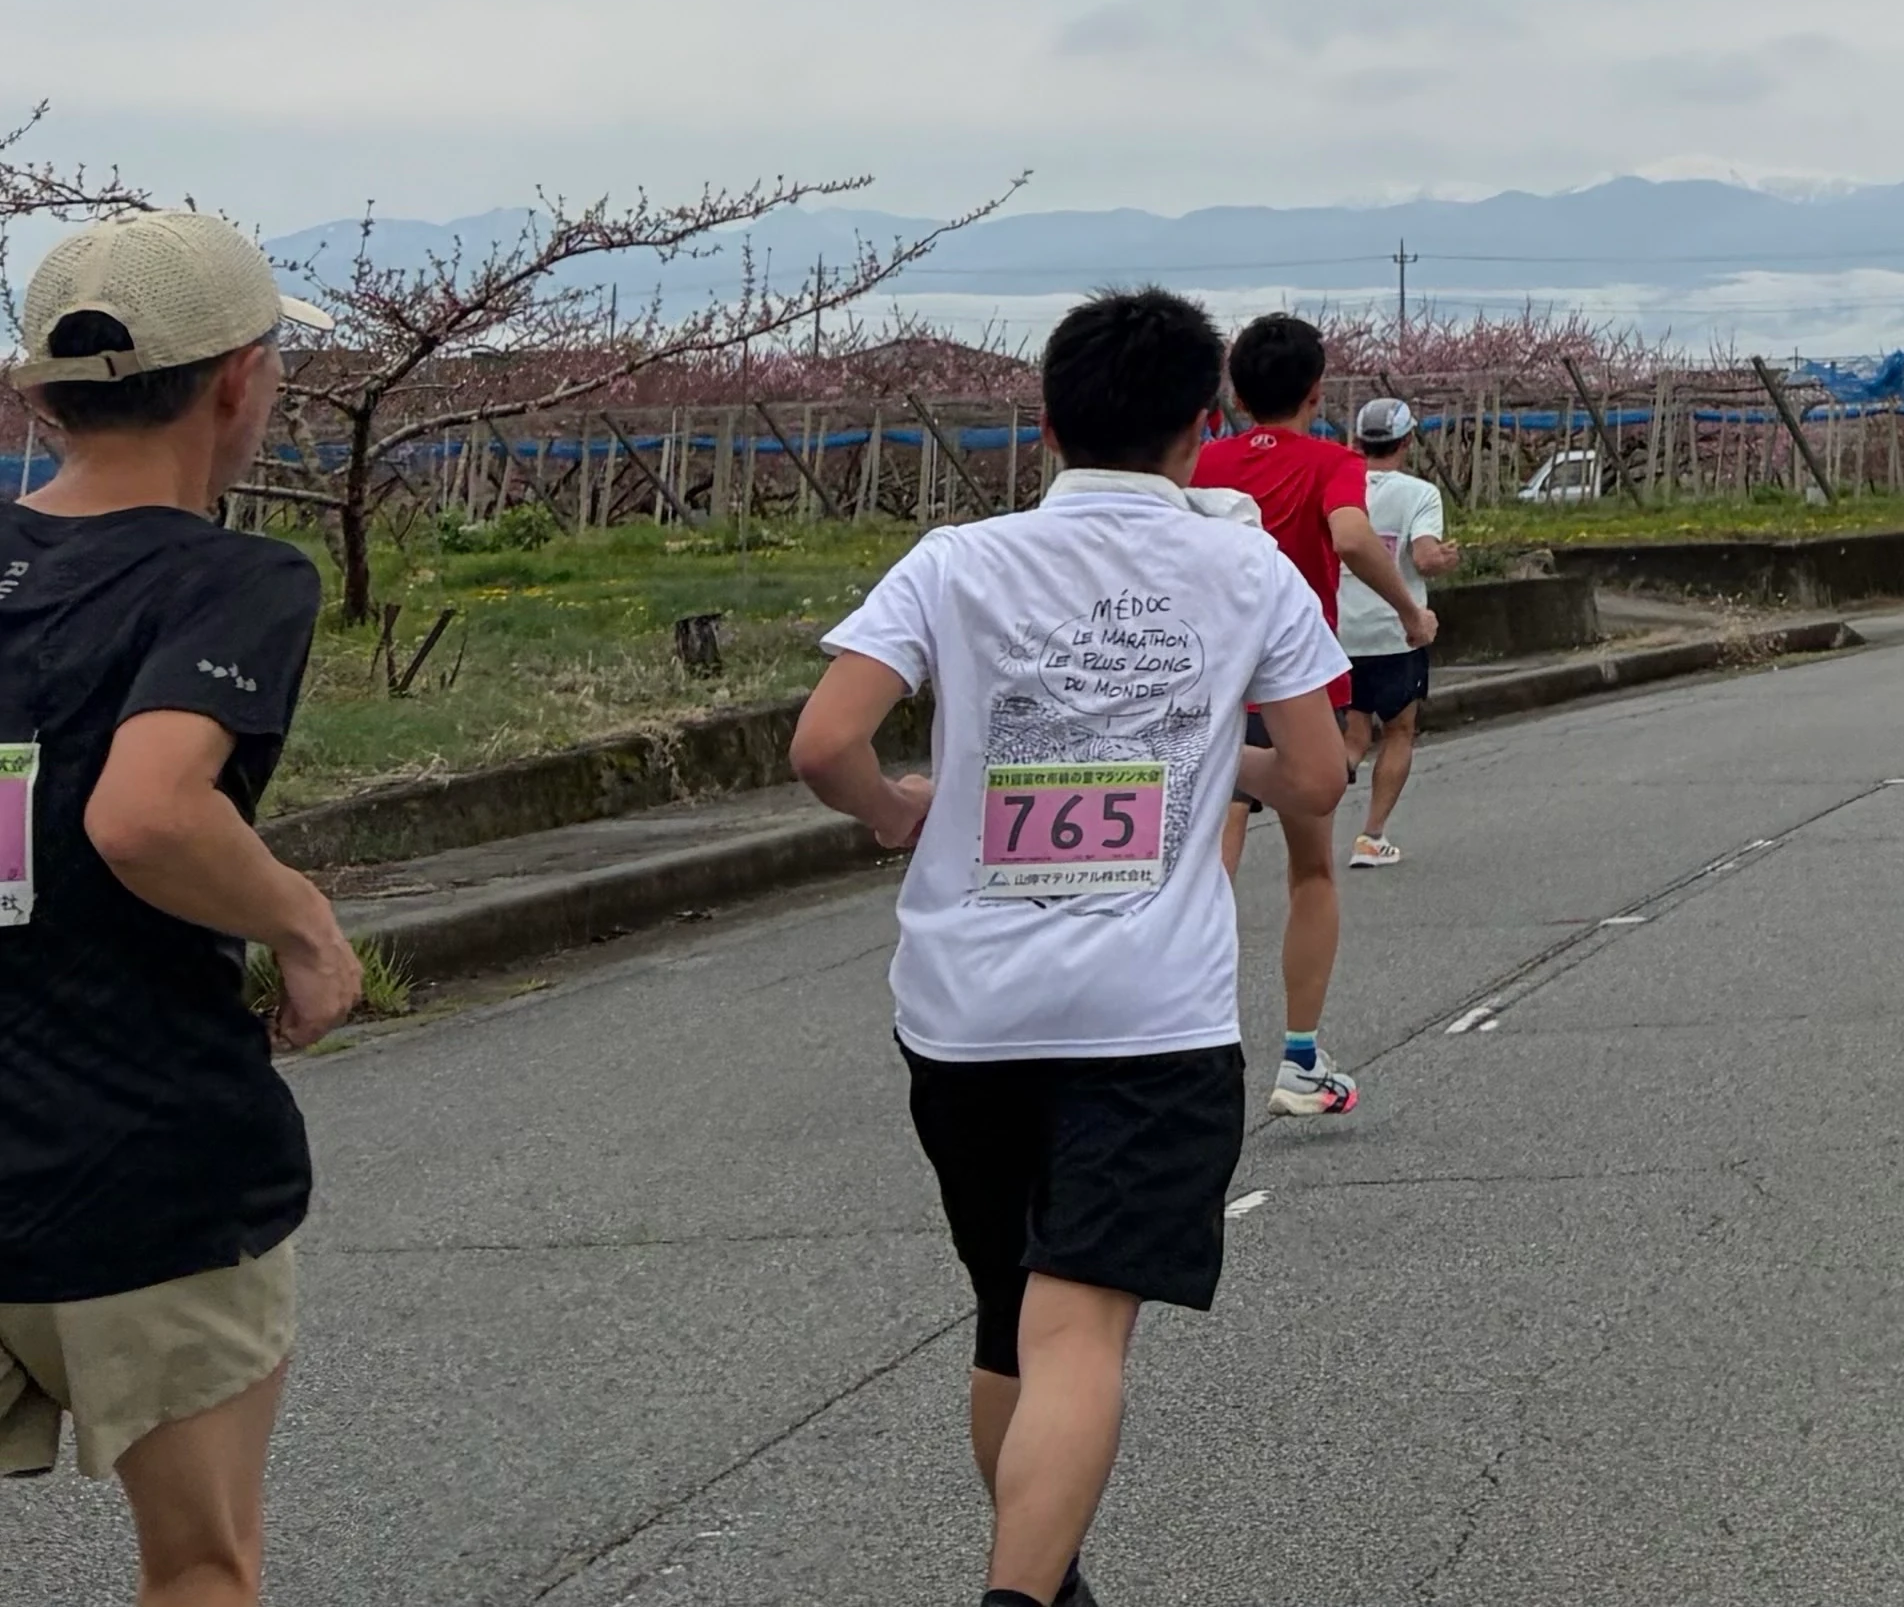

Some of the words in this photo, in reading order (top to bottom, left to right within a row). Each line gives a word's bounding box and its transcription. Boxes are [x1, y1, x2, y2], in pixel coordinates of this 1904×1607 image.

[1091, 589, 1171, 622] MÉDOC
[1072, 630, 1094, 646] LE
[1101, 629, 1188, 649] MARATHON
[1045, 652, 1072, 669] LE
[1082, 652, 1126, 671] PLUS
[1134, 654, 1193, 673] LONG
[1064, 677, 1086, 692] DU
[1094, 679, 1170, 699] MONDE
[1004, 792, 1137, 853] 765
